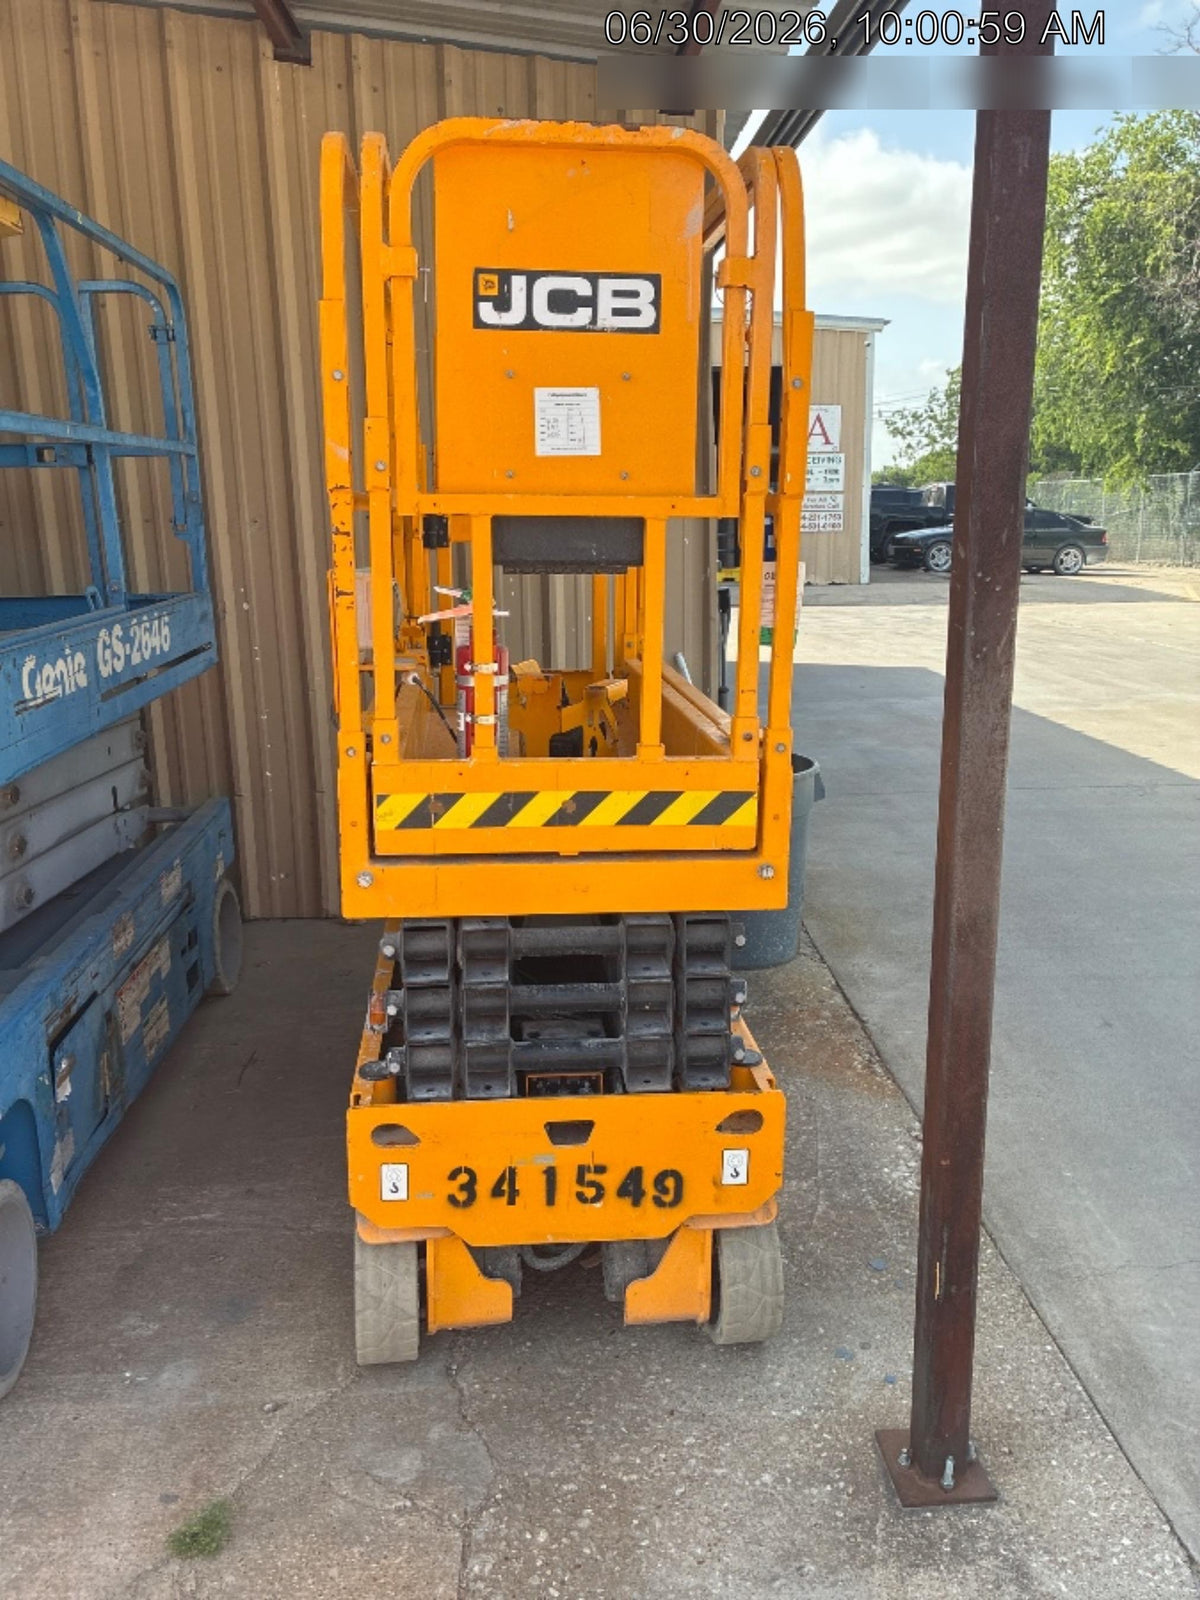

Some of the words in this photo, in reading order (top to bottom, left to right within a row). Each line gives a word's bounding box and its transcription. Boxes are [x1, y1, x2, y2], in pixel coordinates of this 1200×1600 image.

[478, 275, 657, 328] JCB
[21, 644, 89, 706] Genie
[97, 611, 171, 679] GS-2646
[446, 1164, 685, 1209] 341549
